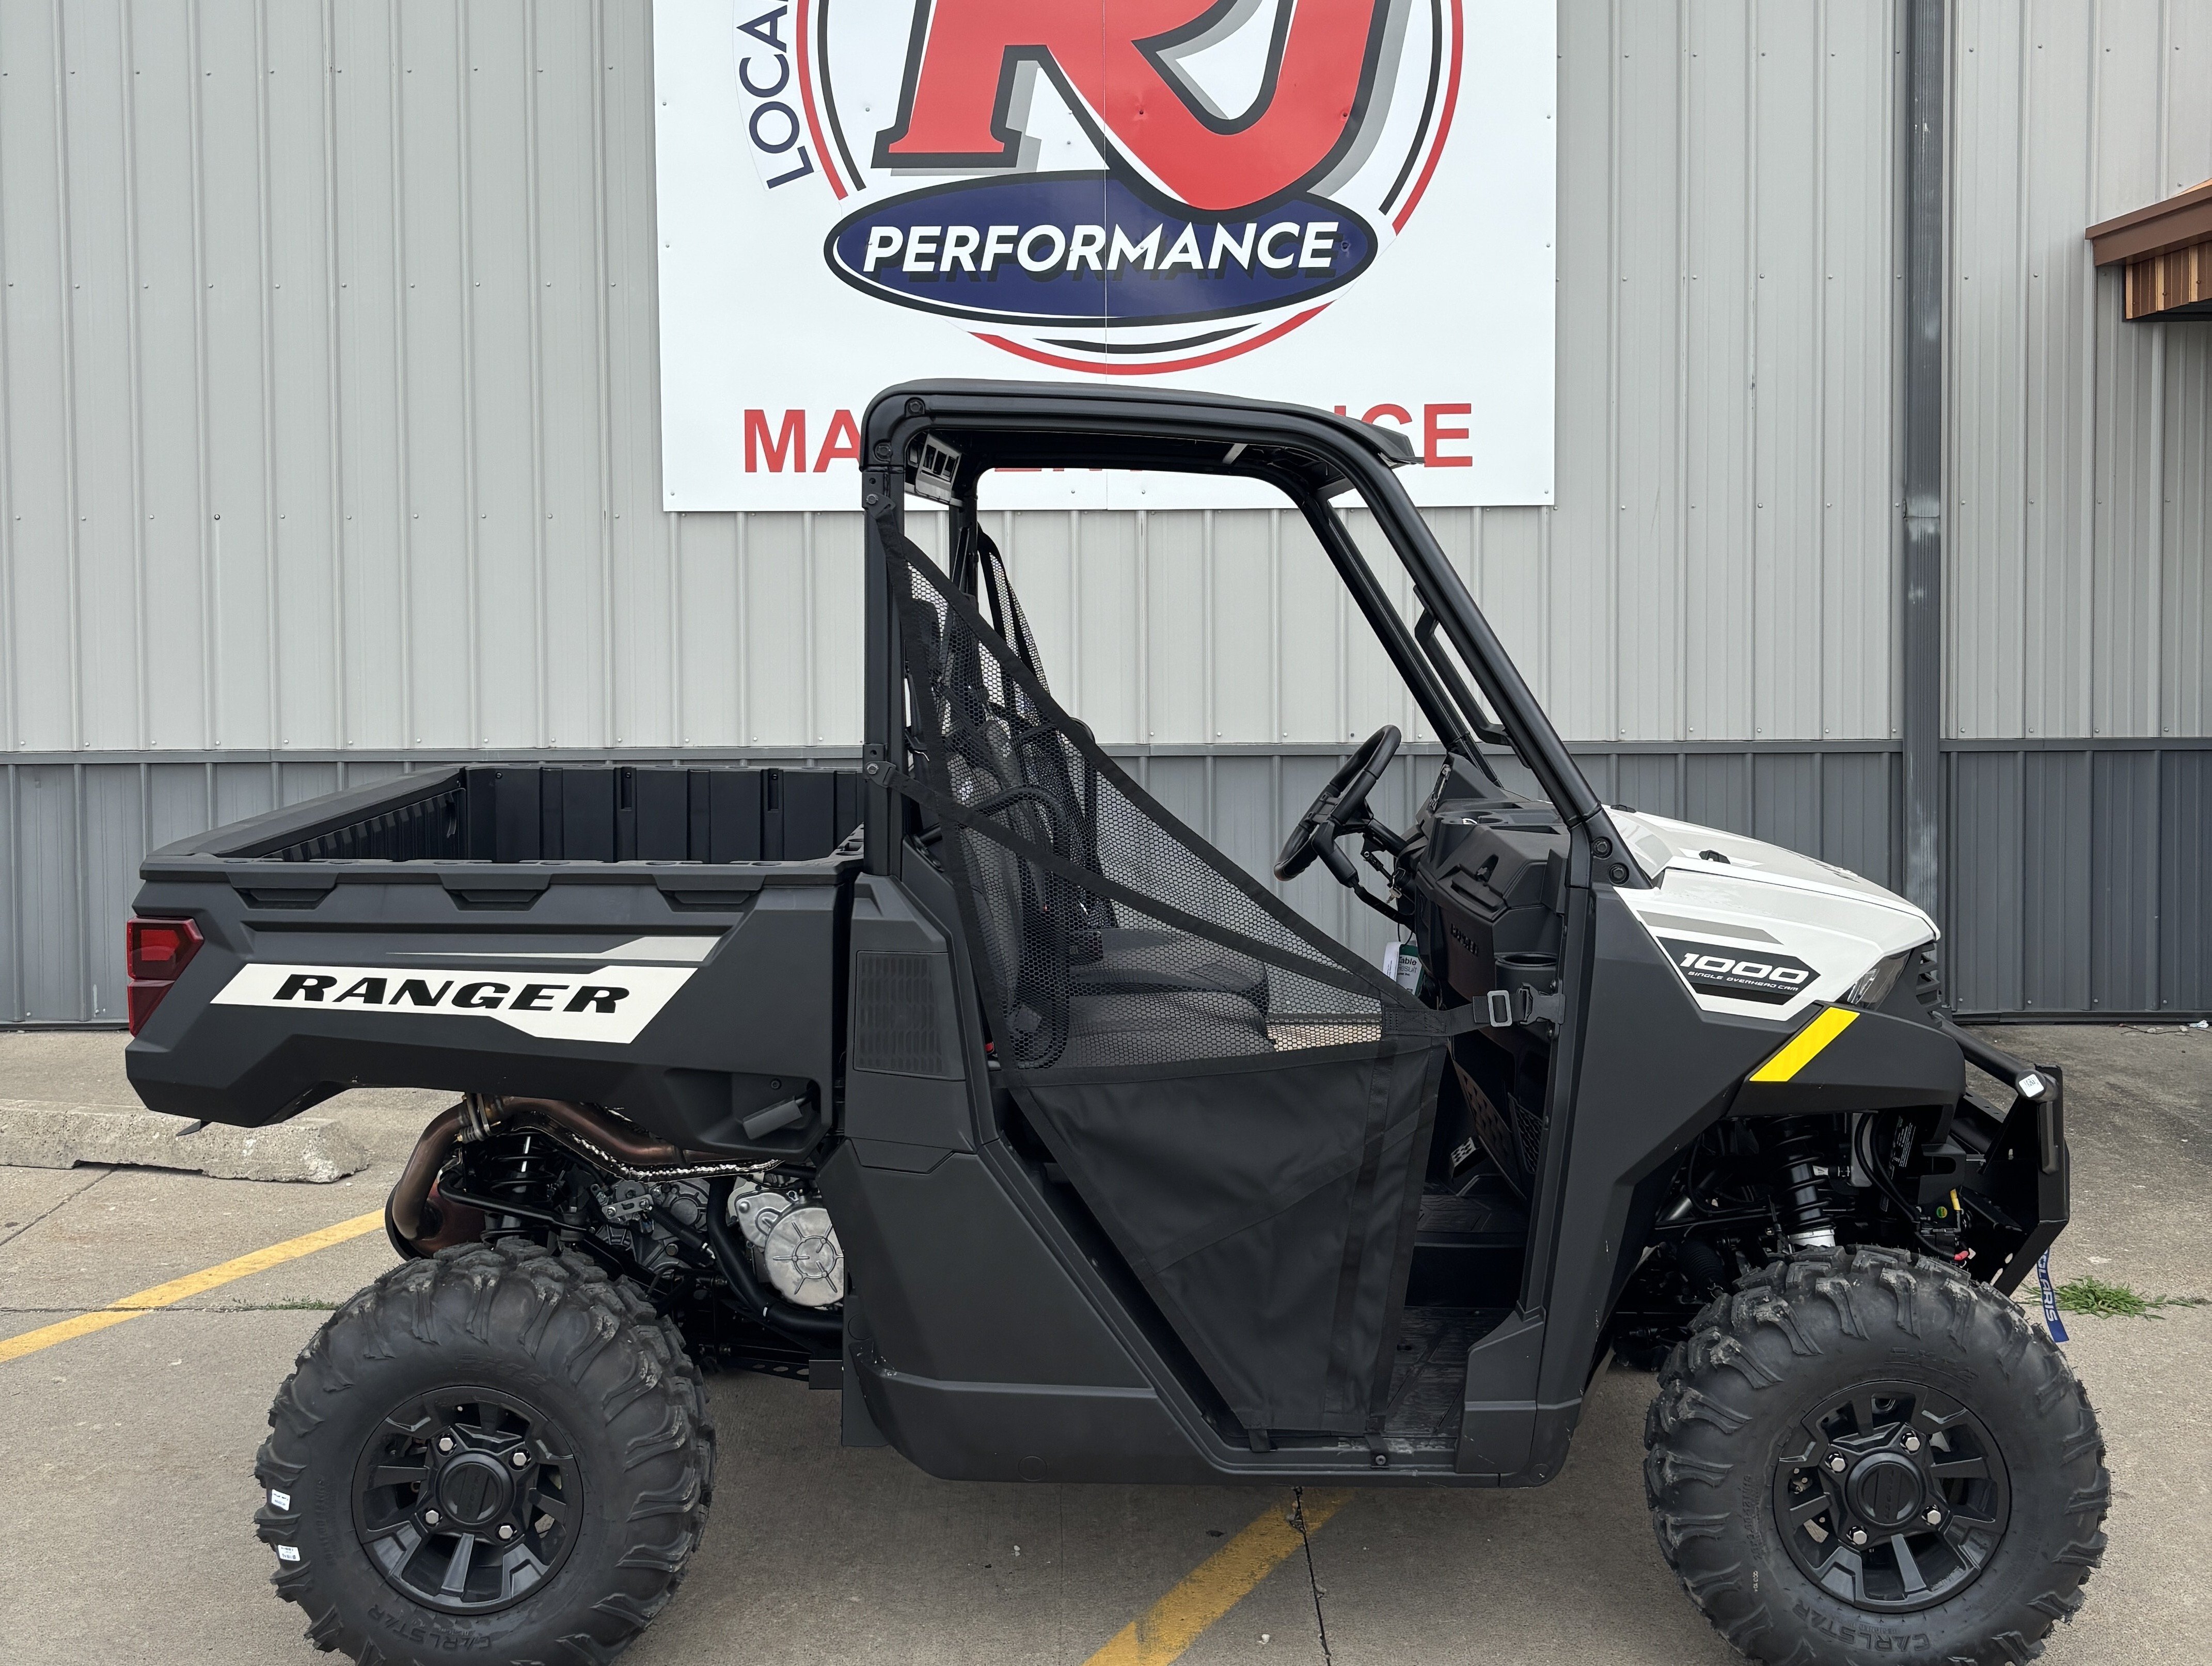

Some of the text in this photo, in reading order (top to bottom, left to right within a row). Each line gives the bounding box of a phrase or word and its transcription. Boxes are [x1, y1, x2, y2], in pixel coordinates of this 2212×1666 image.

[736, 0, 814, 189] LOCA
[863, 221, 1340, 273] PERFORMANCE
[273, 974, 630, 1013] RANGER
[1680, 953, 1809, 984] 1000
[1687, 971, 1724, 980] SINGLE
[1726, 977, 1777, 989] OVERHEAD
[2037, 1249, 2058, 1322] OLARIS
[1792, 1598, 1931, 1652] CARLSTAR
